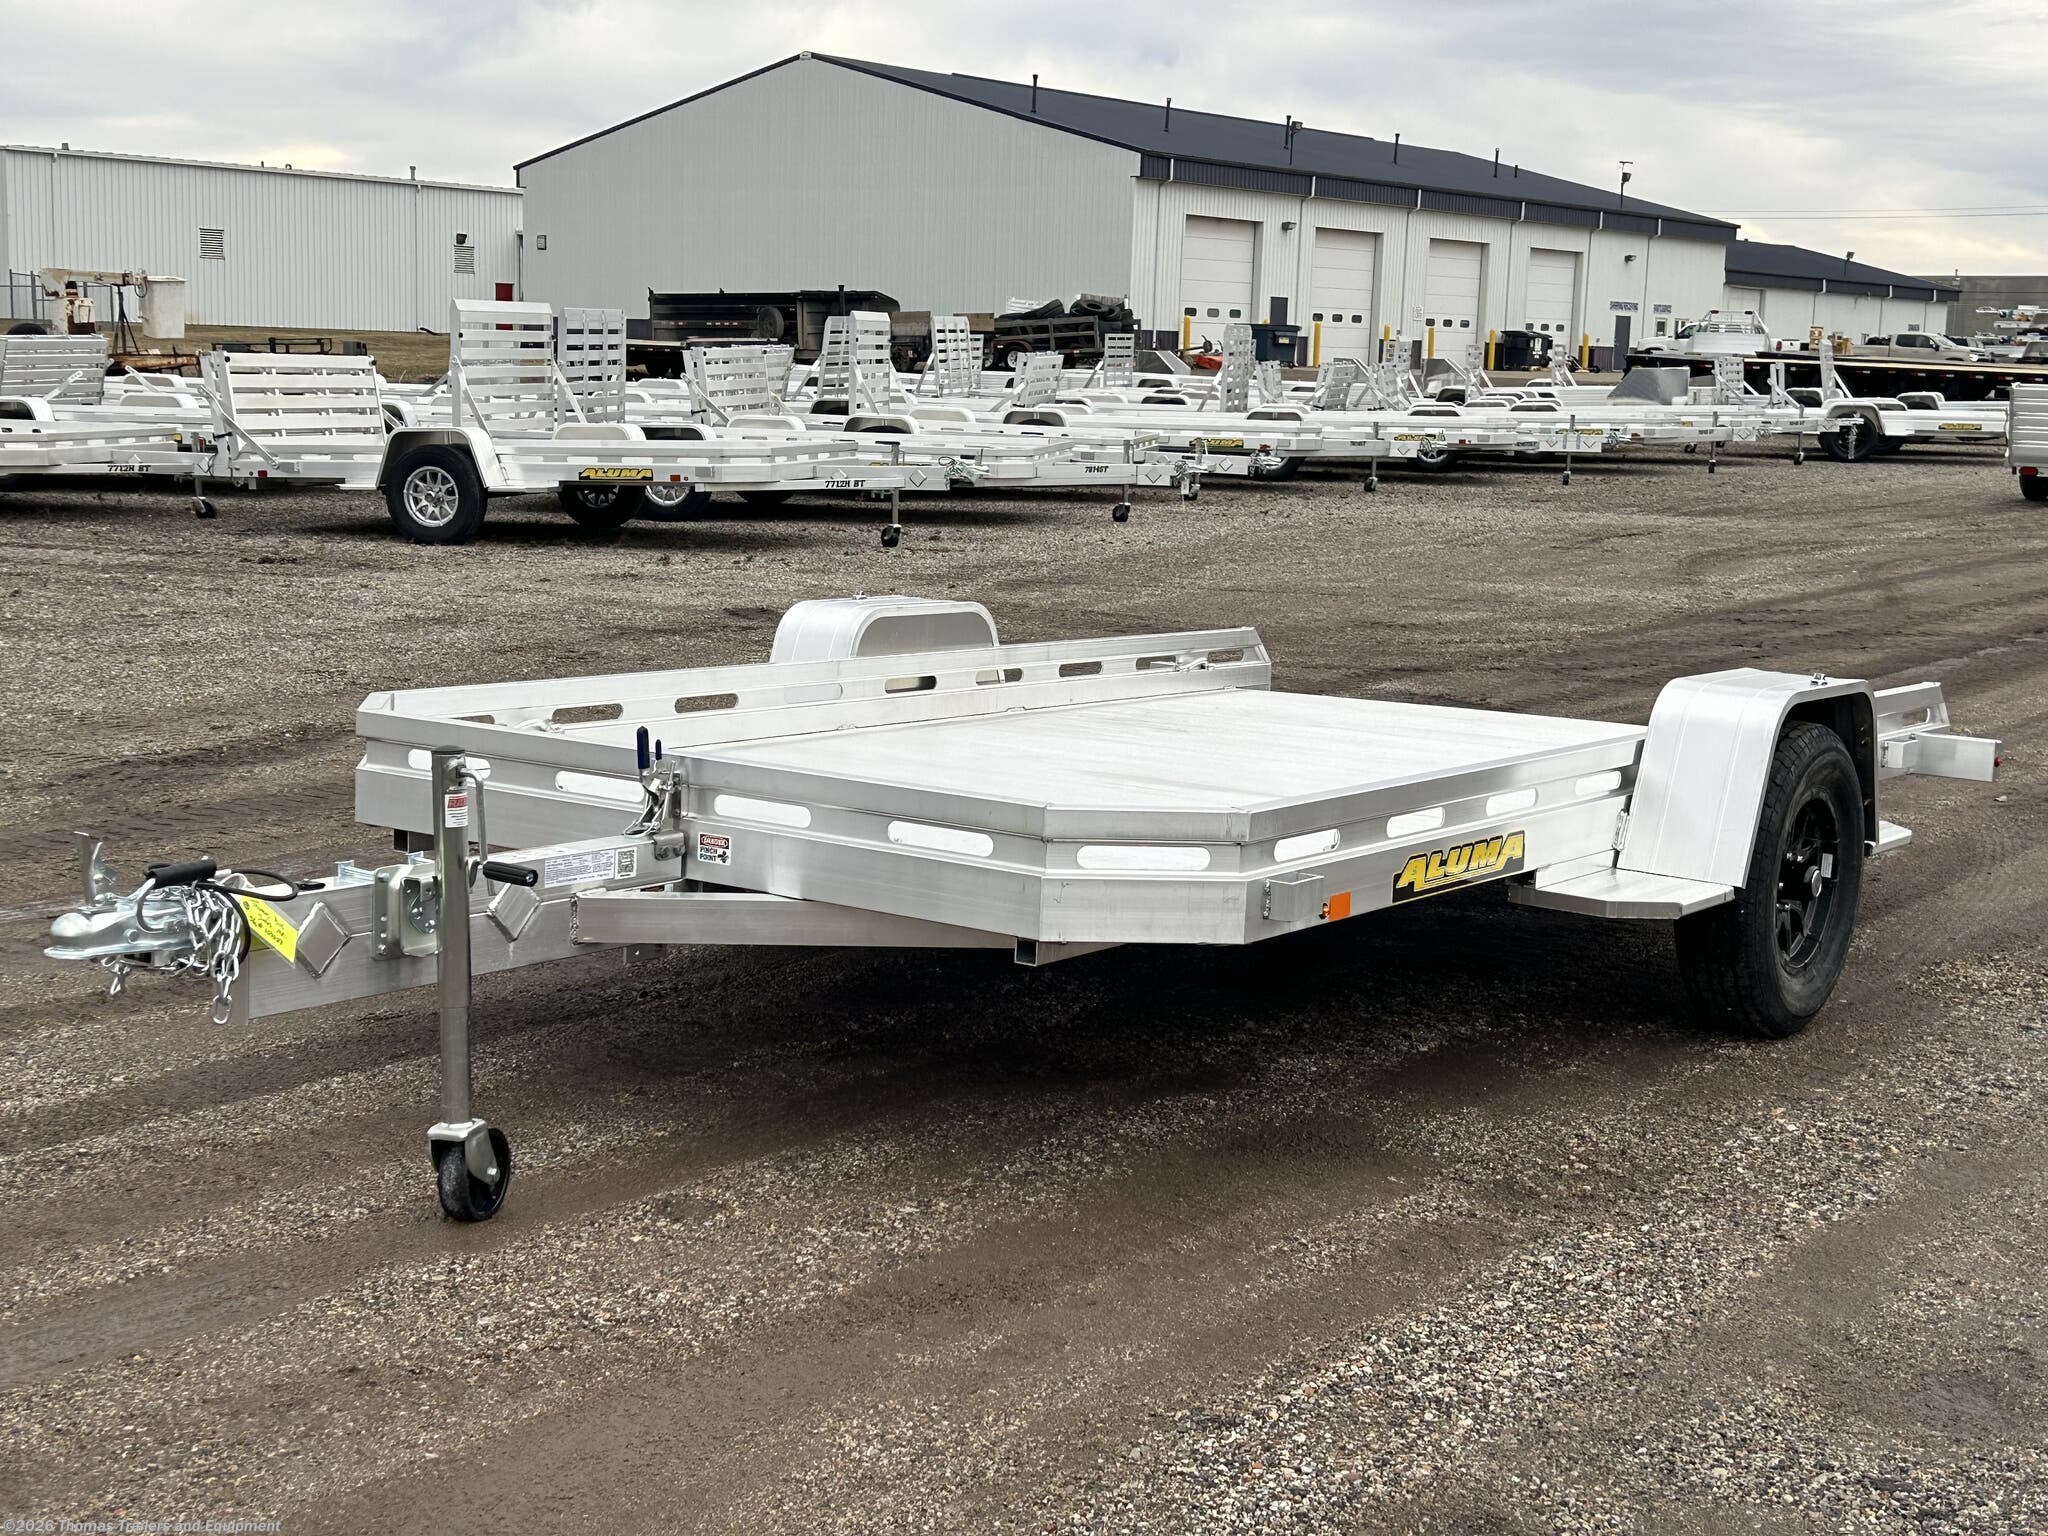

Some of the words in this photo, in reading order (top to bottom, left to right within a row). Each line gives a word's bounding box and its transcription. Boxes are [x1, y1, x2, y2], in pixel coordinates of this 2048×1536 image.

[107, 464, 135, 472] 7712H
[579, 468, 653, 480] ALUMA
[825, 480, 850, 488] 7712H
[853, 479, 866, 488] BT
[700, 846, 718, 855] PINCH
[700, 853, 717, 862] POINT
[1395, 833, 1524, 892] ALUMA
